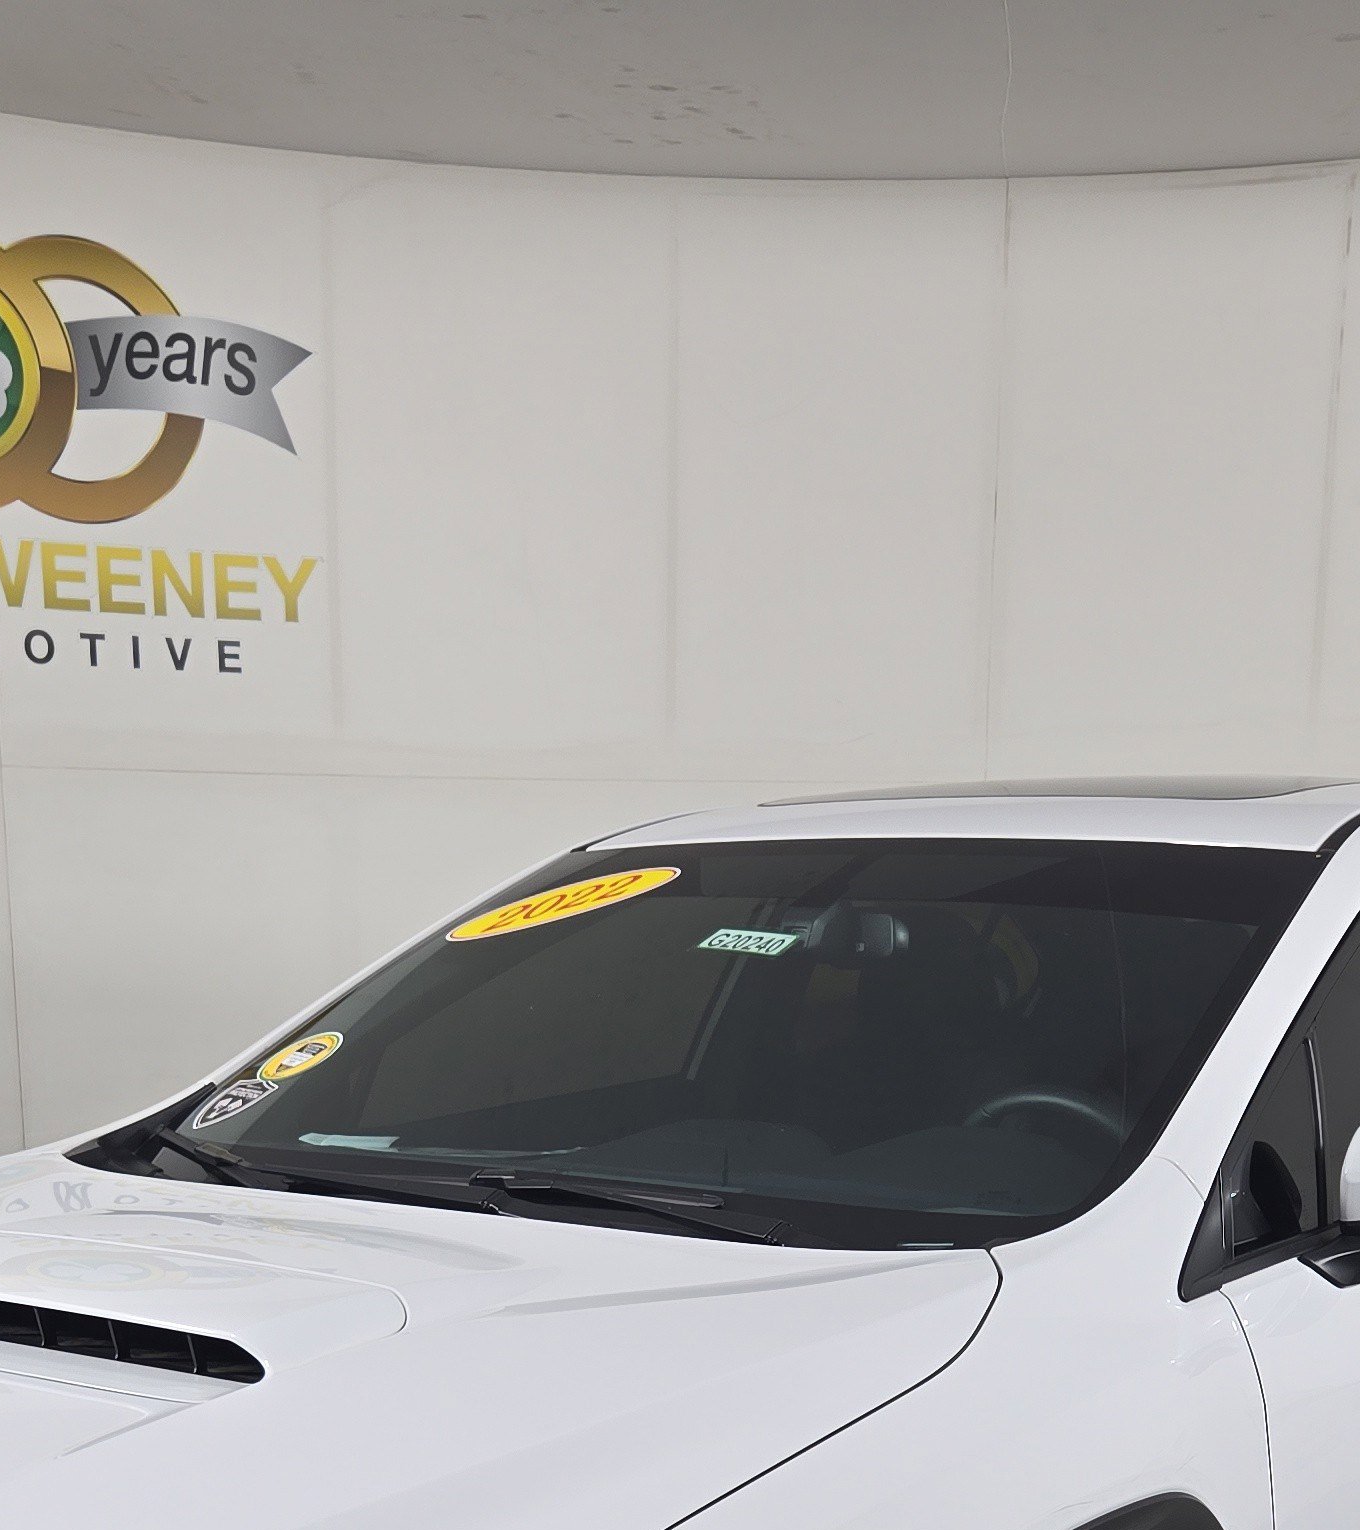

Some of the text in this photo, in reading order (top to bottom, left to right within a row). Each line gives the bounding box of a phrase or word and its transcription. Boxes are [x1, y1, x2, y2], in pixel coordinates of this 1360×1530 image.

[88, 331, 258, 397] years
[479, 874, 643, 933] 2022
[707, 933, 788, 953] G20240
